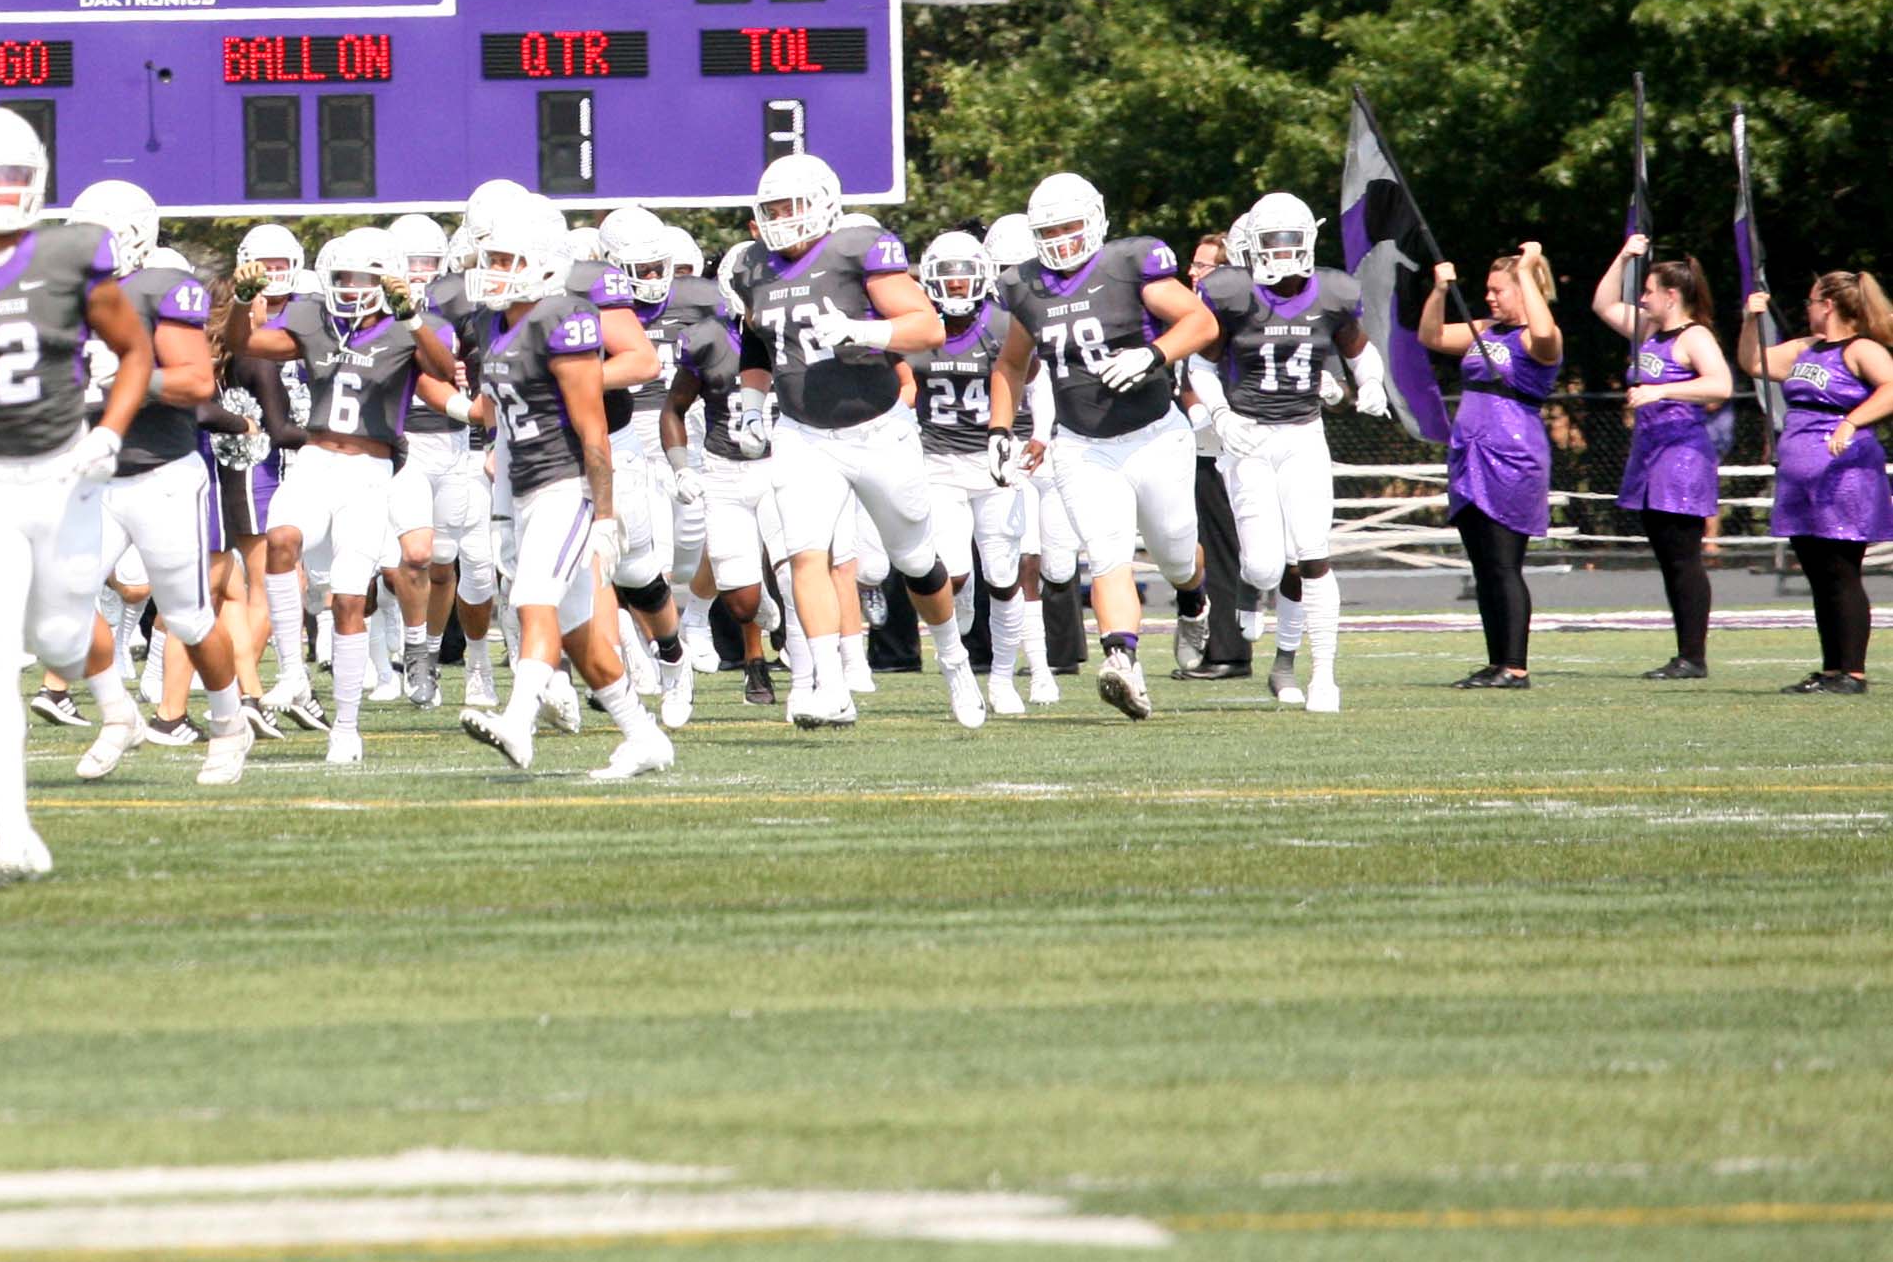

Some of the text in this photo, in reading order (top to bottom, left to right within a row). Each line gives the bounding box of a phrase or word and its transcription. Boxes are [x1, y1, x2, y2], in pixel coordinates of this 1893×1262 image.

[223, 34, 390, 83] BALL ON
[520, 30, 610, 77] QTR
[741, 27, 824, 73] TOL
[578, 96, 593, 180] 1
[877, 241, 906, 264] 72
[175, 285, 205, 311] 47
[603, 273, 629, 296] 52
[563, 318, 598, 346] 32
[761, 303, 836, 365] 72
[1042, 316, 1110, 379] 78
[1259, 342, 1314, 391] 14
[328, 371, 363, 435] 6
[927, 378, 991, 425] 24
